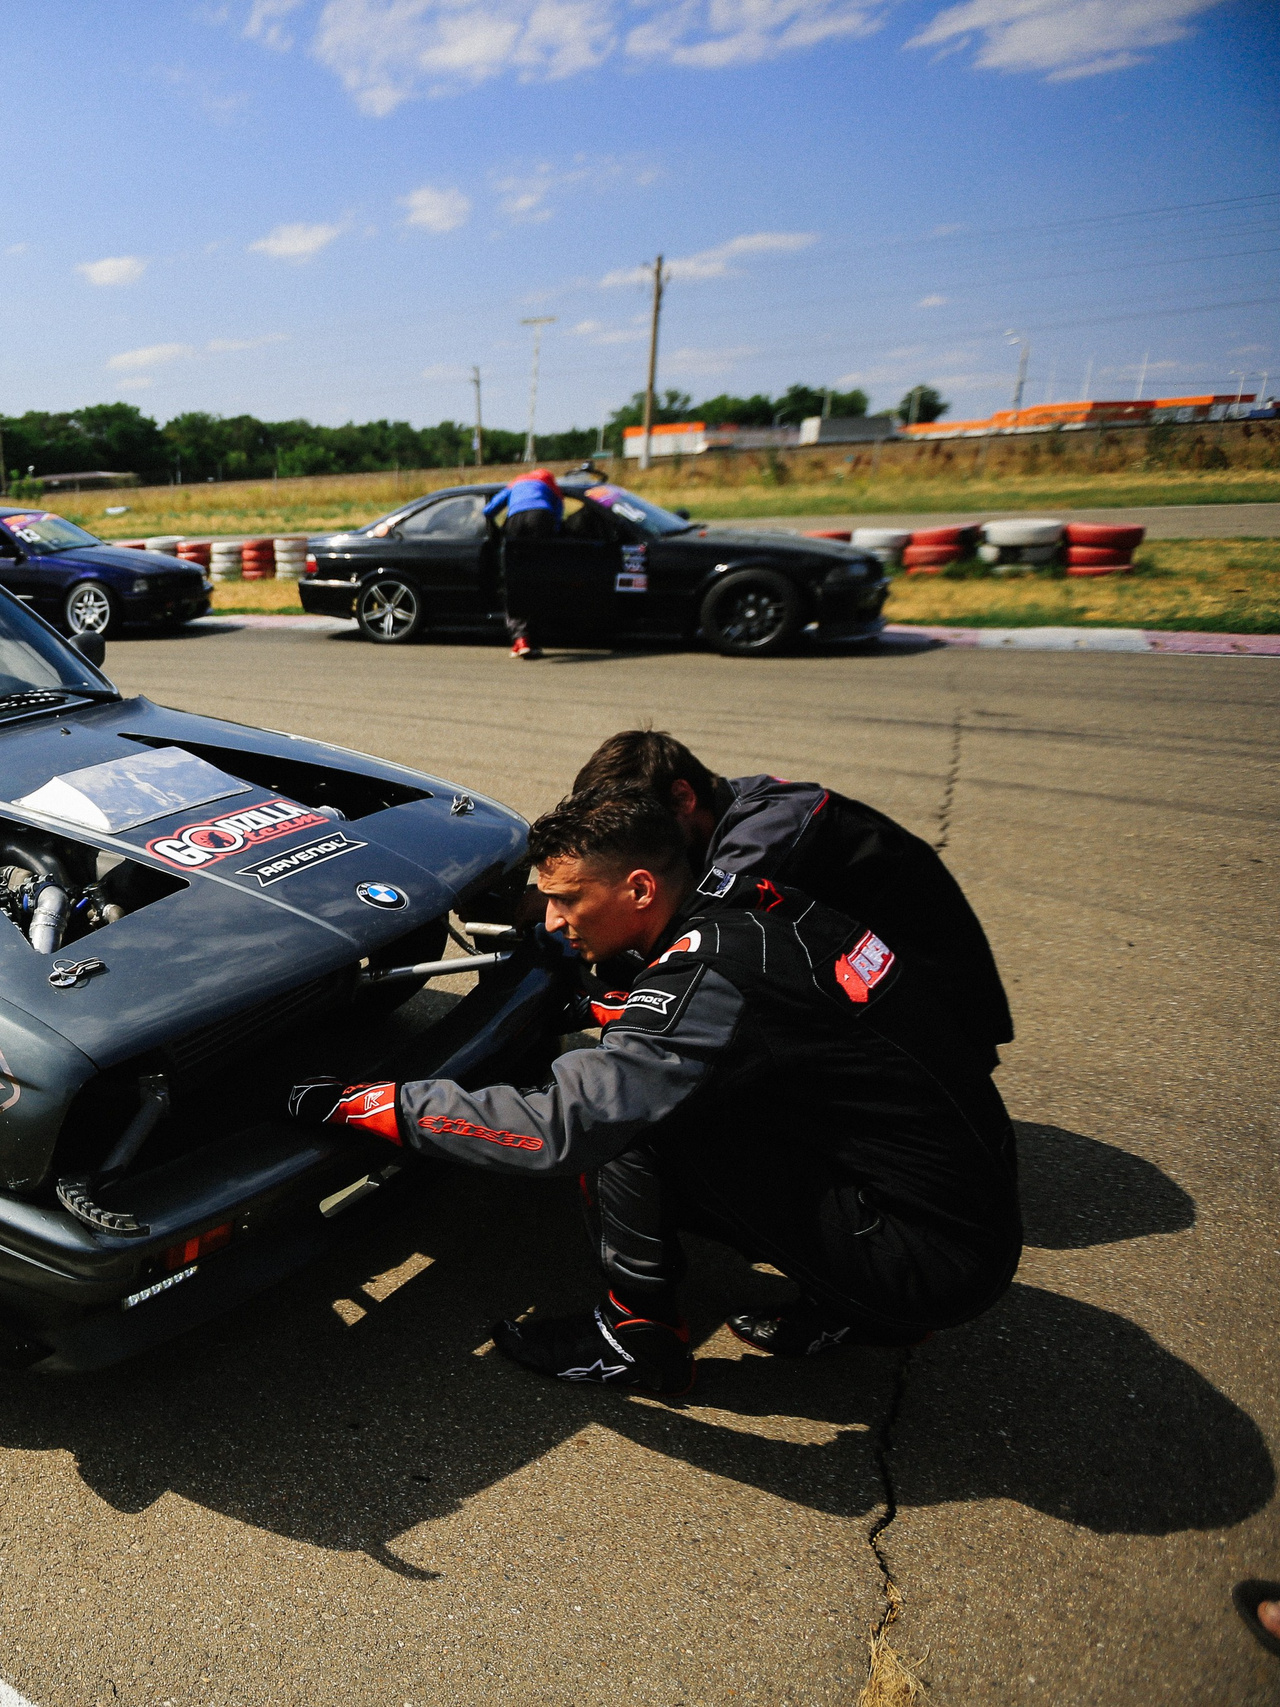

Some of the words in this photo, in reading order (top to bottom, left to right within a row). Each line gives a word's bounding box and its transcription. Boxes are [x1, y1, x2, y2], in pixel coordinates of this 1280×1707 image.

[154, 802, 313, 866] GODZILLA
[244, 813, 320, 841] team
[257, 838, 348, 878] RAVENOL
